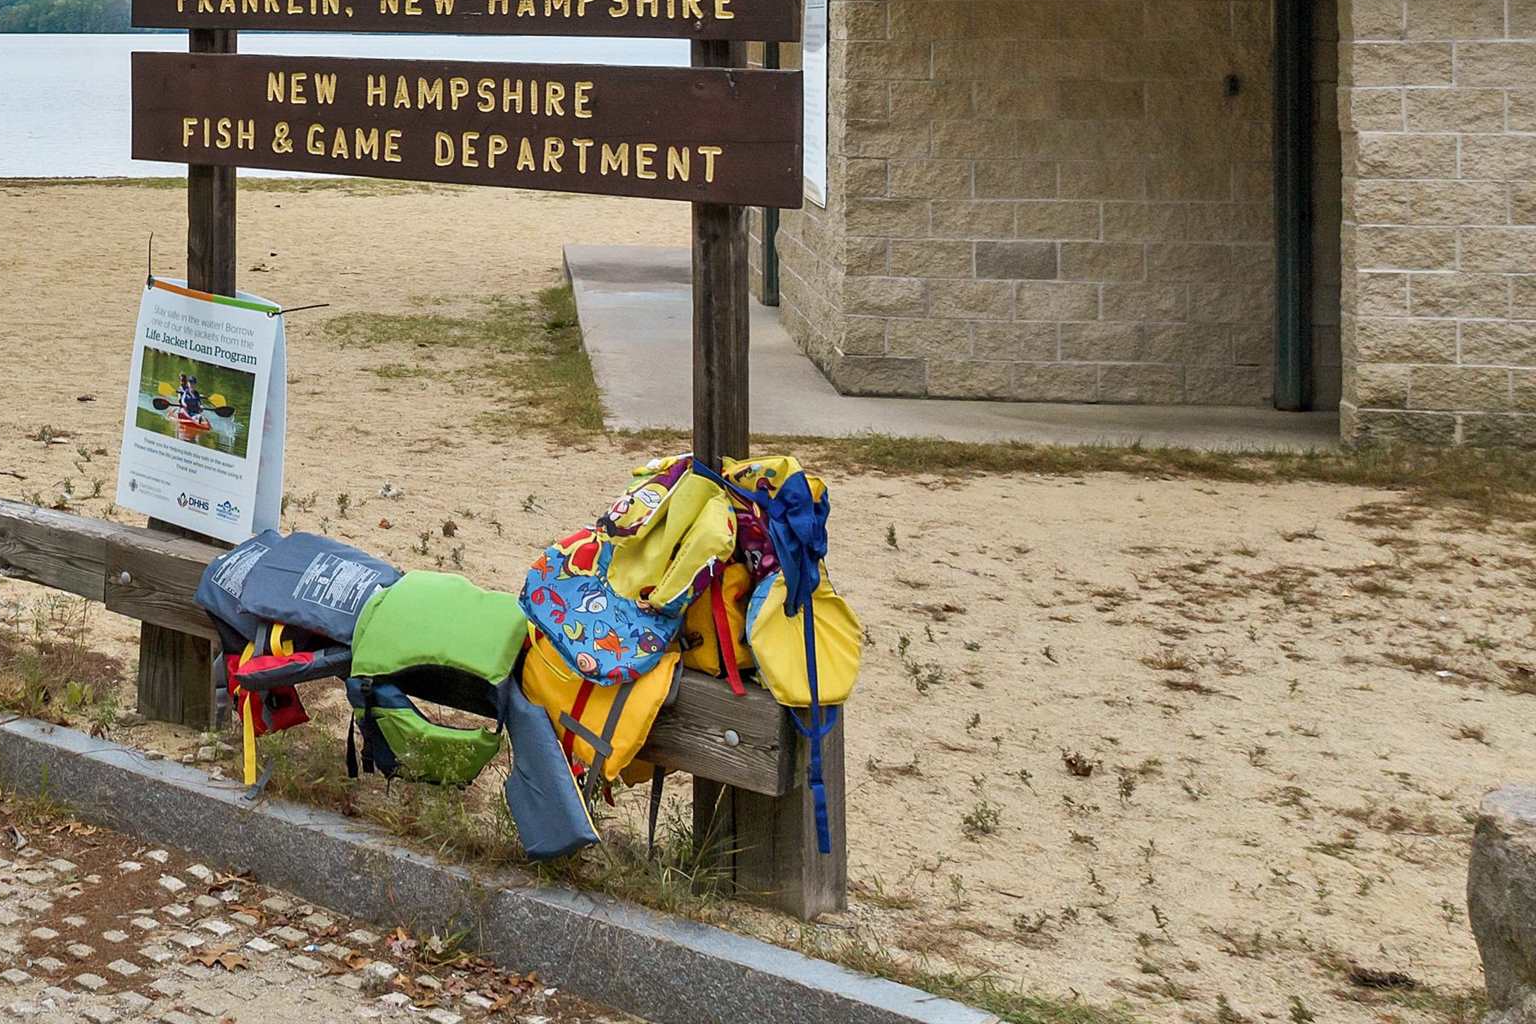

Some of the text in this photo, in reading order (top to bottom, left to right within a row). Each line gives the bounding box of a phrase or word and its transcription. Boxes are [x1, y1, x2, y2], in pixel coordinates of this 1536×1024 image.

[267, 71, 594, 119] NEW HAMPSHIRE
[182, 117, 723, 183] FISH & GAME DEPARTMENT
[220, 333, 239, 345] from
[241, 338, 255, 350] the
[225, 322, 255, 336] Borrow
[146, 327, 258, 366] Life Jacket Loan Program
[188, 496, 210, 511] DHHS
